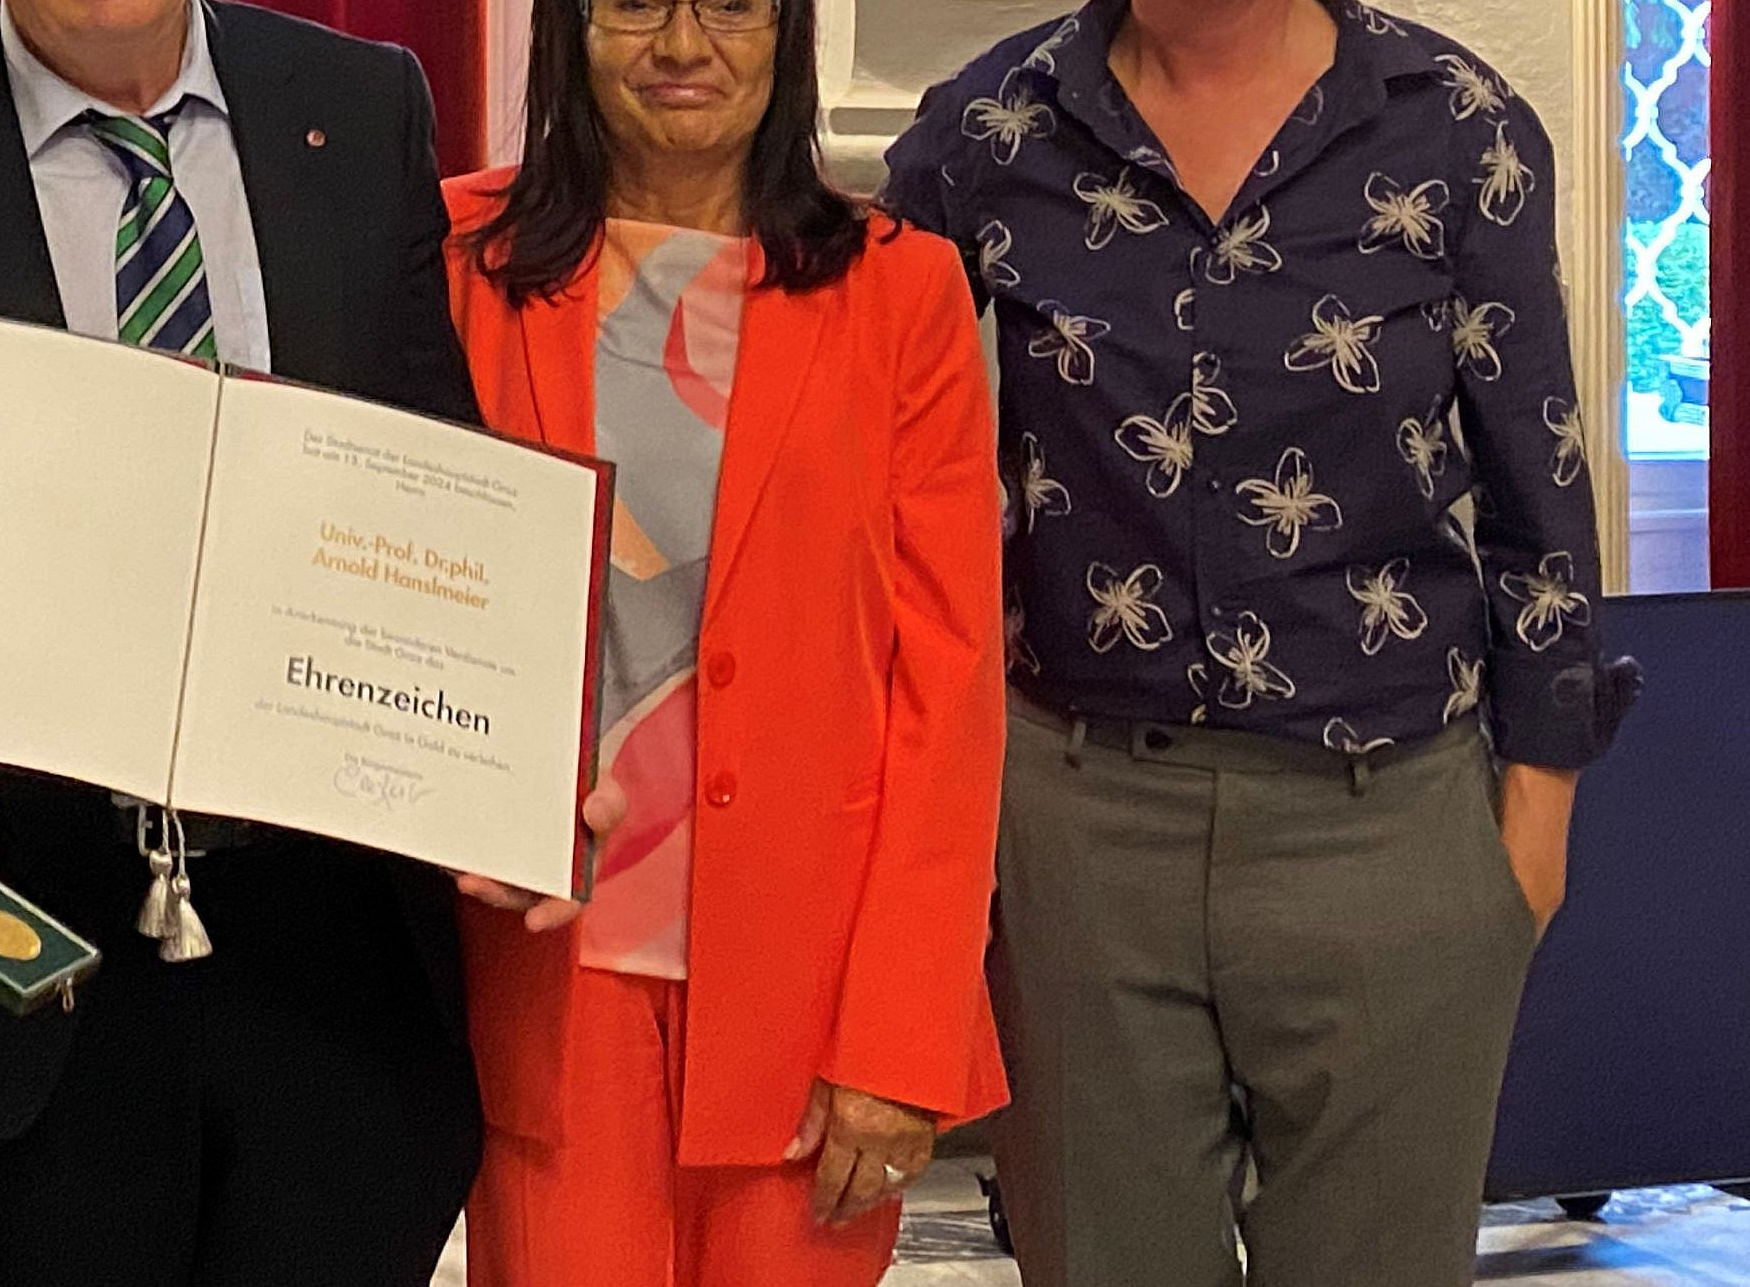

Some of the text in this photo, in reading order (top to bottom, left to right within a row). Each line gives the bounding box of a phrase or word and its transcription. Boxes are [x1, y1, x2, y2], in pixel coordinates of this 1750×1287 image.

[320, 519, 419, 566] Univ.-Prof.
[312, 546, 490, 611] Arnold Hanslmeier
[286, 655, 491, 736] Ehrenzeichen
